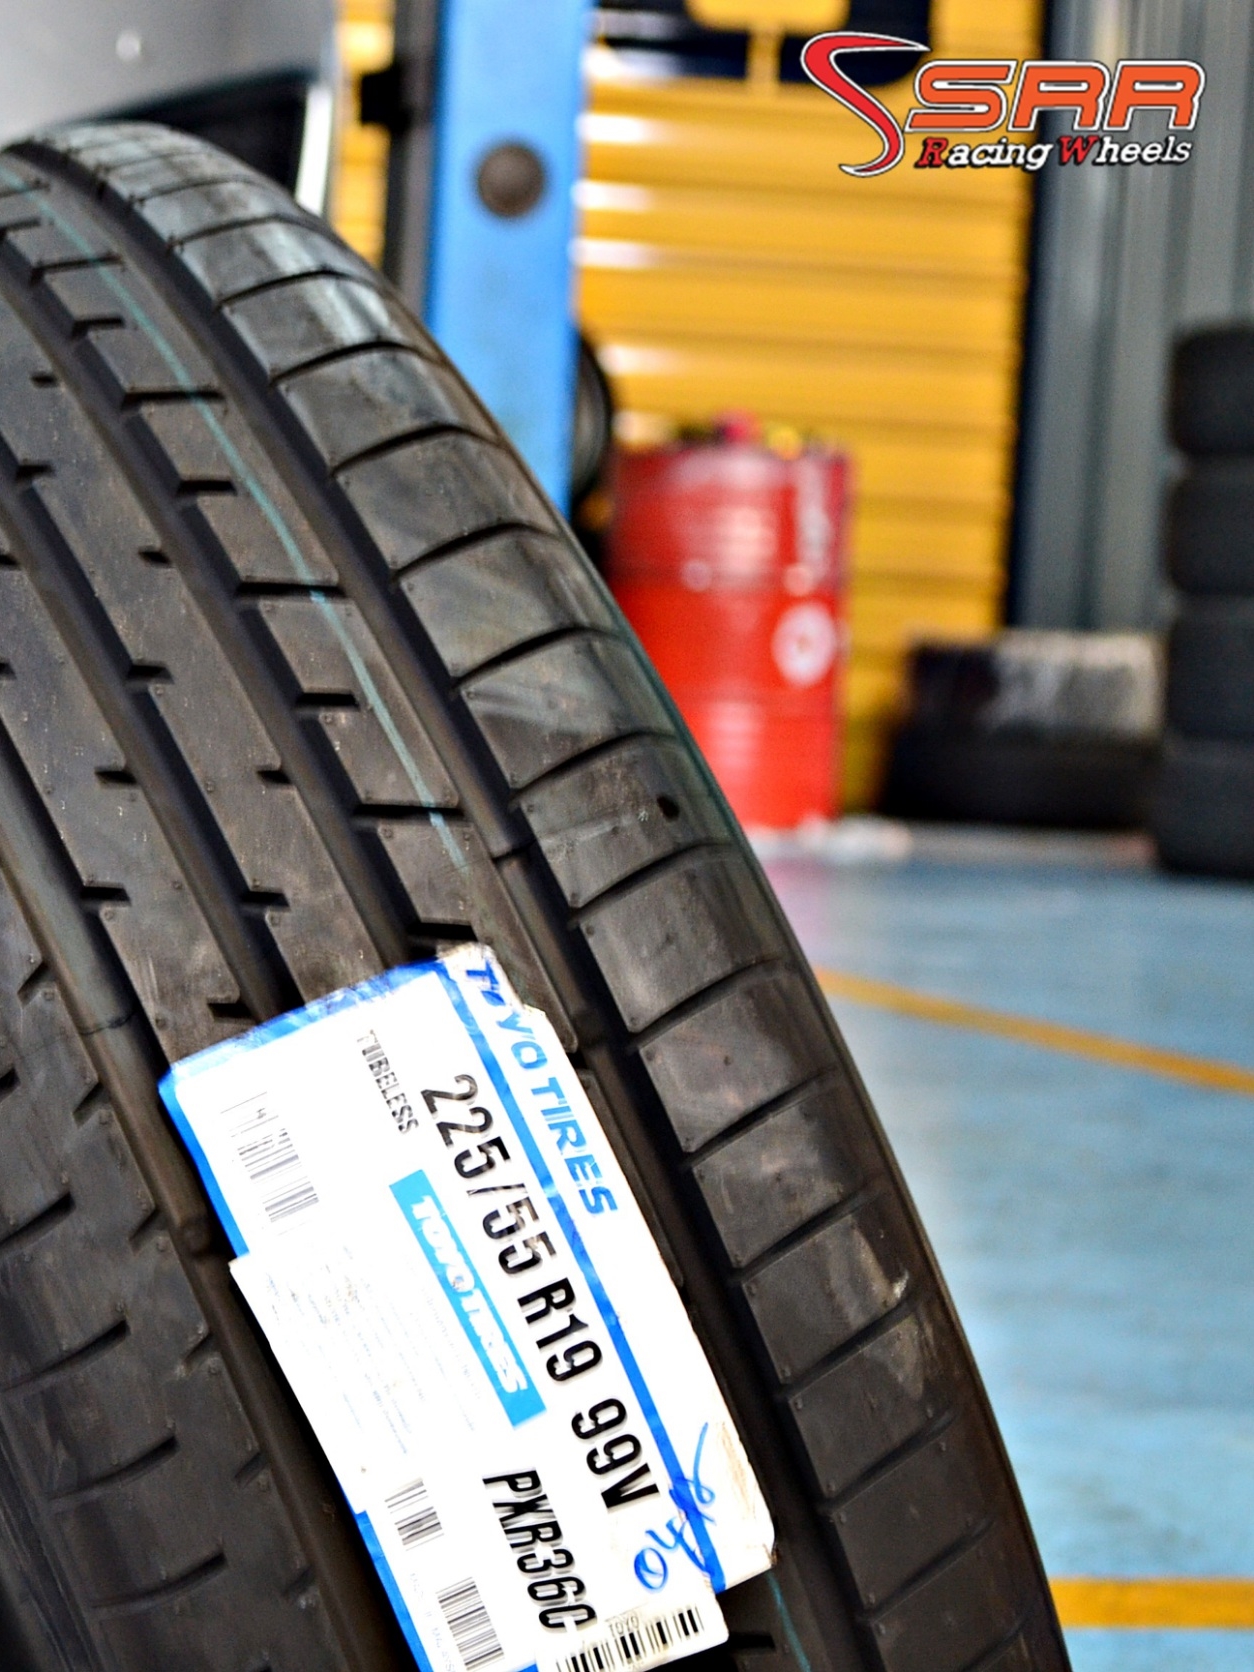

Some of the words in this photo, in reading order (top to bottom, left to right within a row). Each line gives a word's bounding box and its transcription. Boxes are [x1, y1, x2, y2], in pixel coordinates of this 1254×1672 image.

[357, 1029, 419, 1134] TUBELESS
[531, 1077, 618, 1214] TIRES
[420, 1073, 558, 1275] 225/55
[517, 1277, 604, 1384] R19
[571, 1397, 660, 1511] 99V
[482, 1467, 598, 1632] PXR36C
